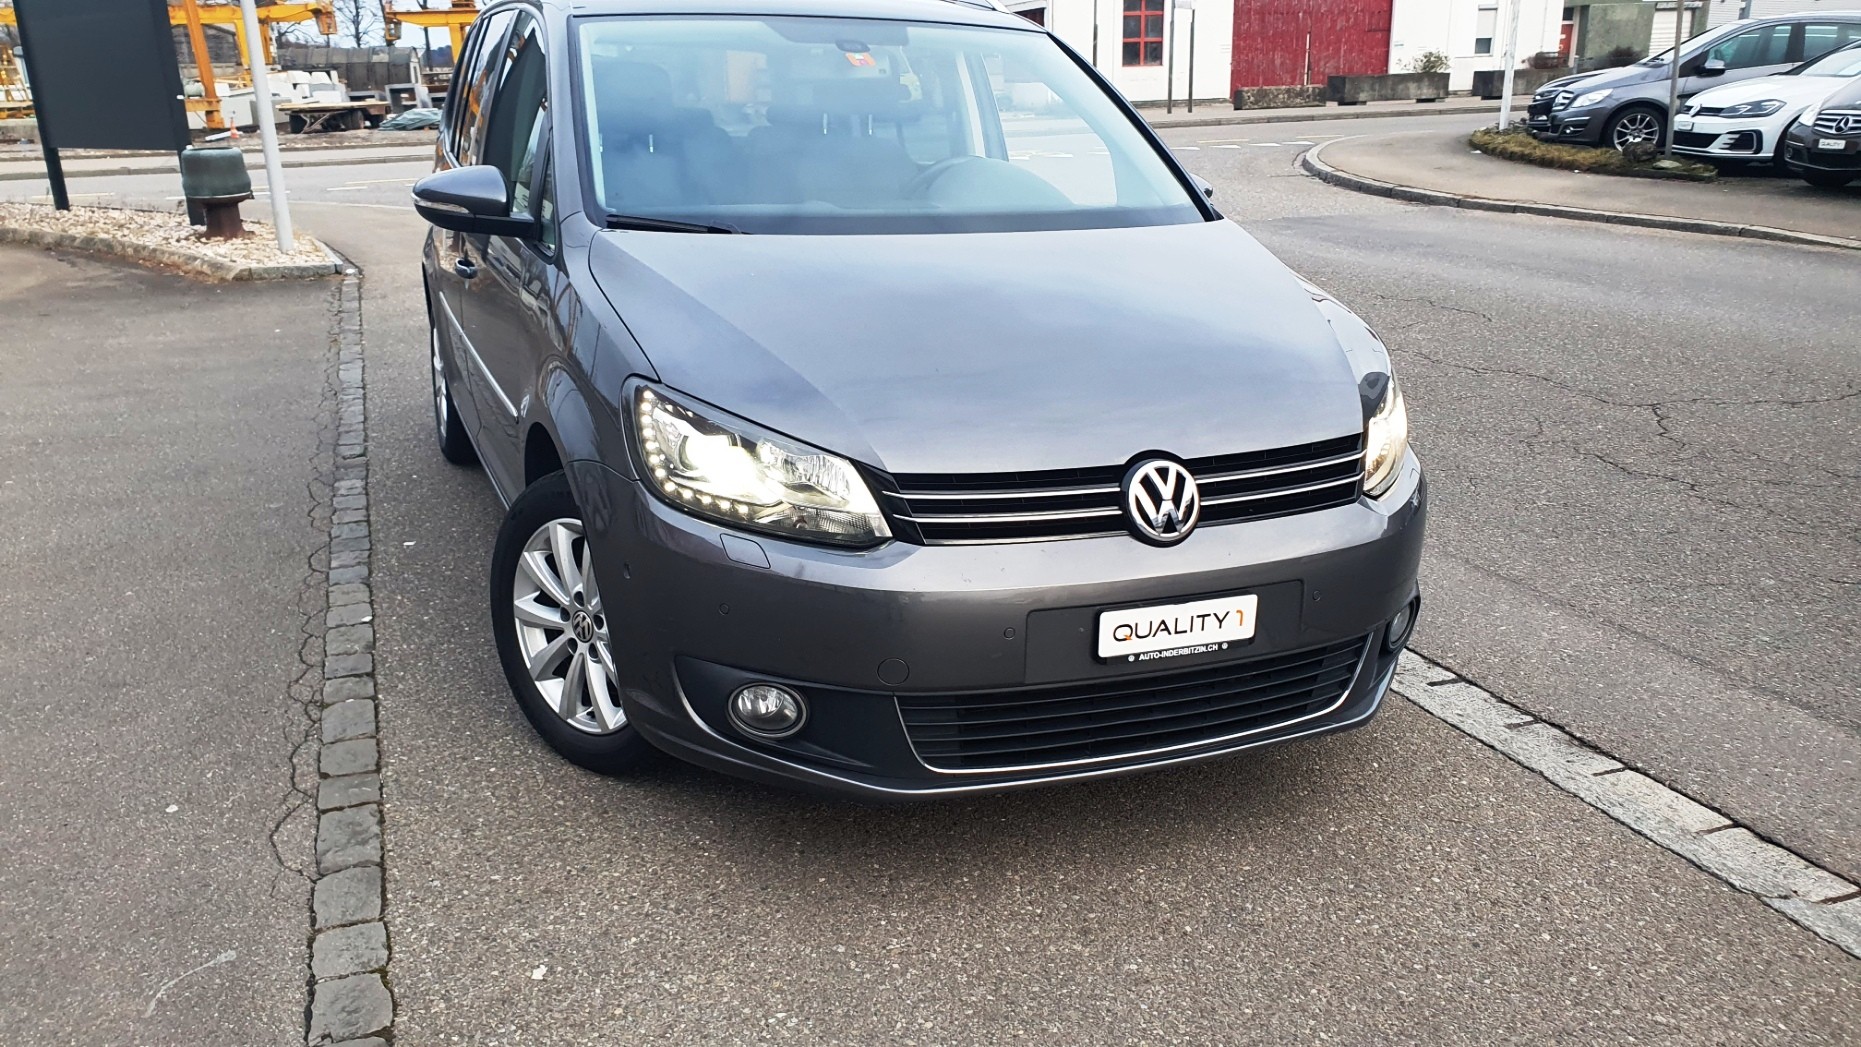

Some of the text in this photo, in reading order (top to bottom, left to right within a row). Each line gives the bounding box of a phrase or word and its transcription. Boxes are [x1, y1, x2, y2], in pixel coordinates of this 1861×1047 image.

[1130, 461, 1198, 538] VW
[1113, 611, 1230, 642] QUALITY
[1139, 643, 1218, 661] AUTO-INDERBITZIN.CH
